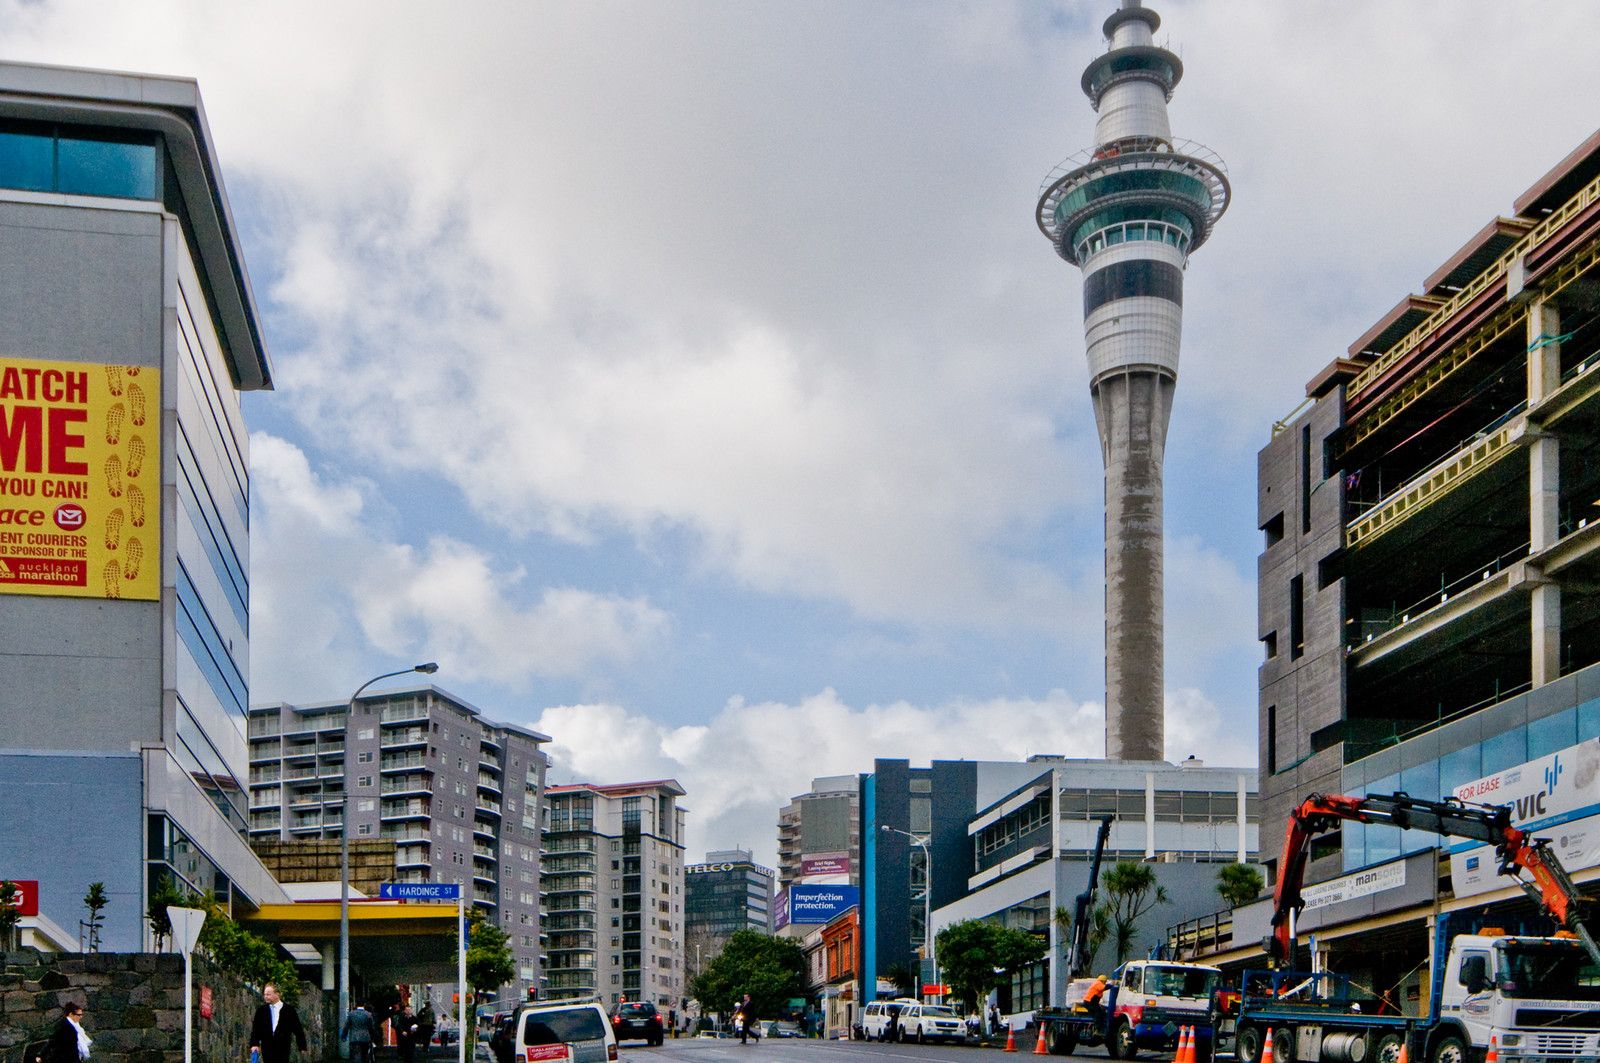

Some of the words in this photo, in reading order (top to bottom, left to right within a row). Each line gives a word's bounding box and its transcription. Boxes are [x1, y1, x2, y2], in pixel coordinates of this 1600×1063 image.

[0, 366, 88, 404] ATCH
[0, 478, 35, 497] YOU
[41, 480, 88, 499] CAN!
[0, 532, 24, 544] ENT
[27, 533, 87, 547] COURIERS
[10, 546, 55, 557] SPONSOR
[57, 548, 69, 557] OF
[71, 549, 88, 558] THE
[19, 563, 79, 573] auckland
[20, 571, 78, 581] marathon
[1459, 786, 1475, 801] FOR
[1476, 777, 1500, 796] LEASE
[399, 887, 440, 896] HARDINGE
[795, 893, 844, 902] Imperfection
[795, 902, 836, 911] protection.
